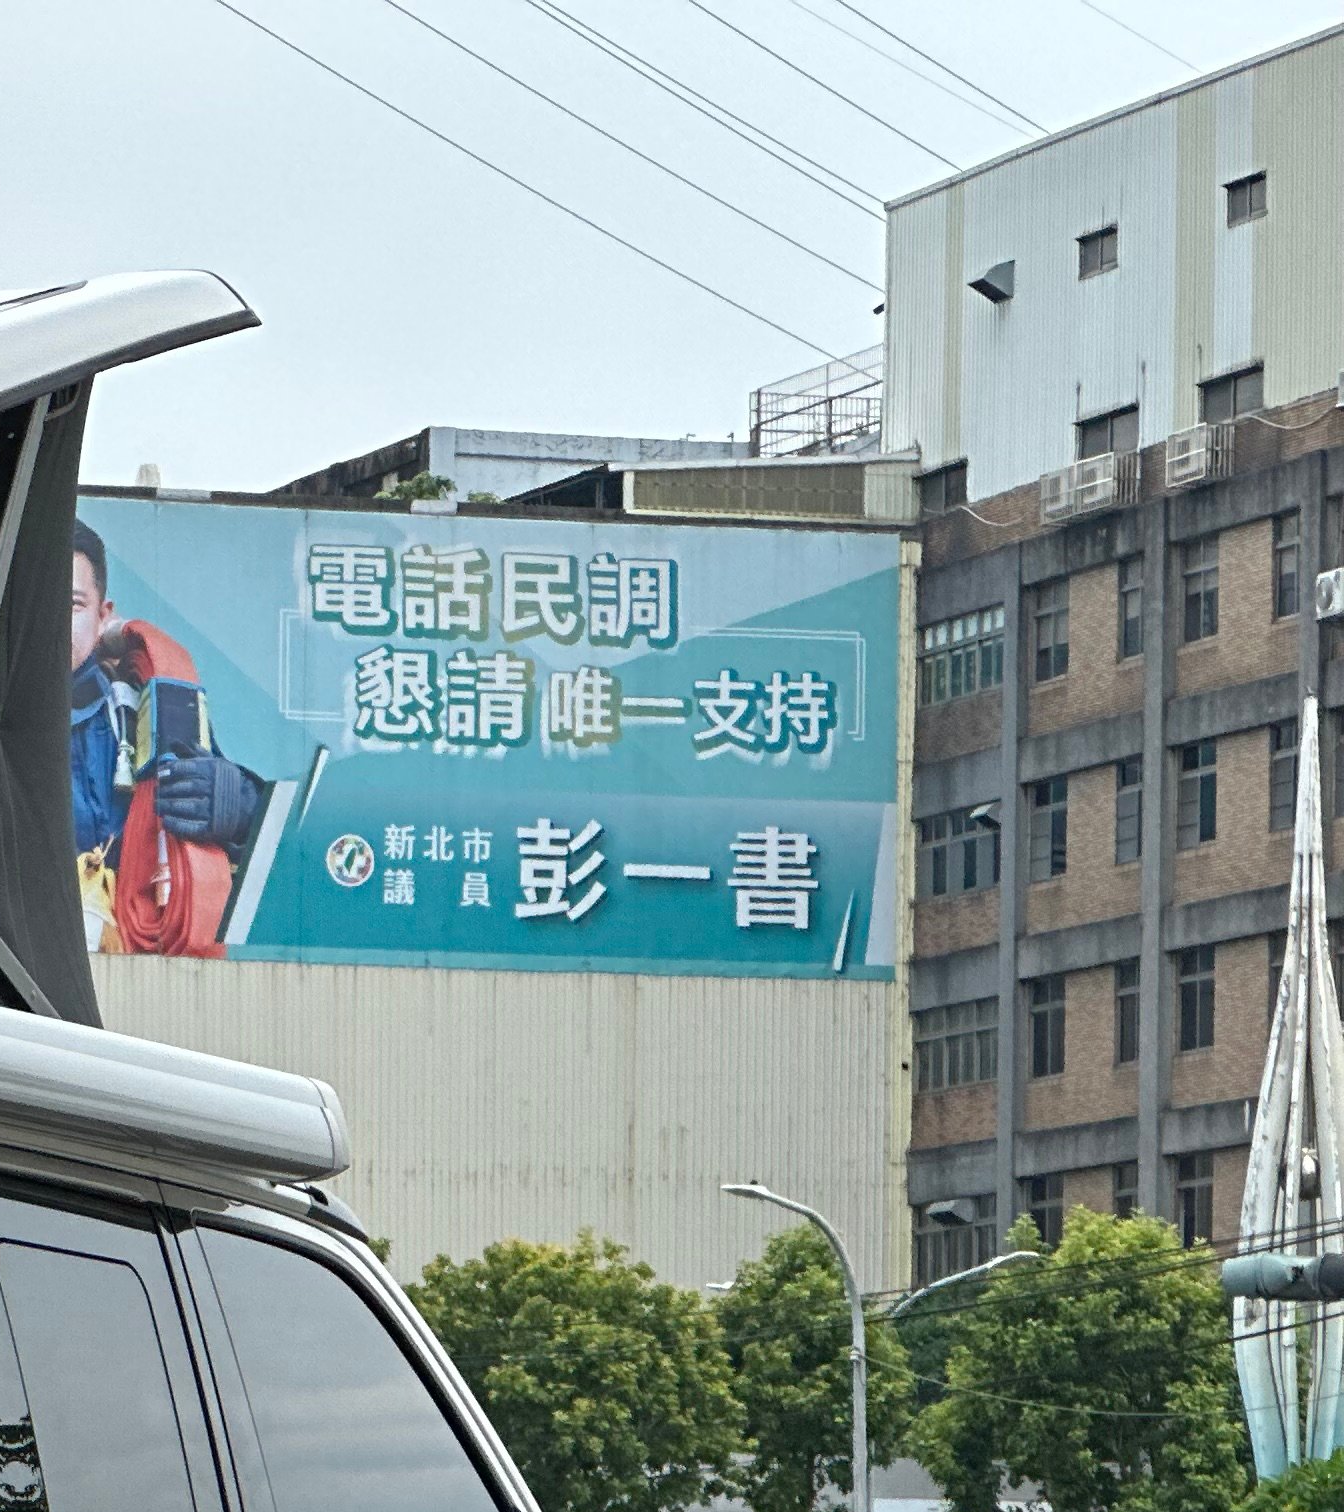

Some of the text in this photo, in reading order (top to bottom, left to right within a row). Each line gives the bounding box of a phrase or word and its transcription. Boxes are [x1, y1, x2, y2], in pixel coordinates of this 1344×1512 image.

[308, 543, 672, 642] 電話民調
[354, 646, 830, 746] 懇請唯一支持
[382, 869, 492, 908] 議員
[383, 823, 494, 863] 新北市
[515, 816, 819, 930] 彭一書
